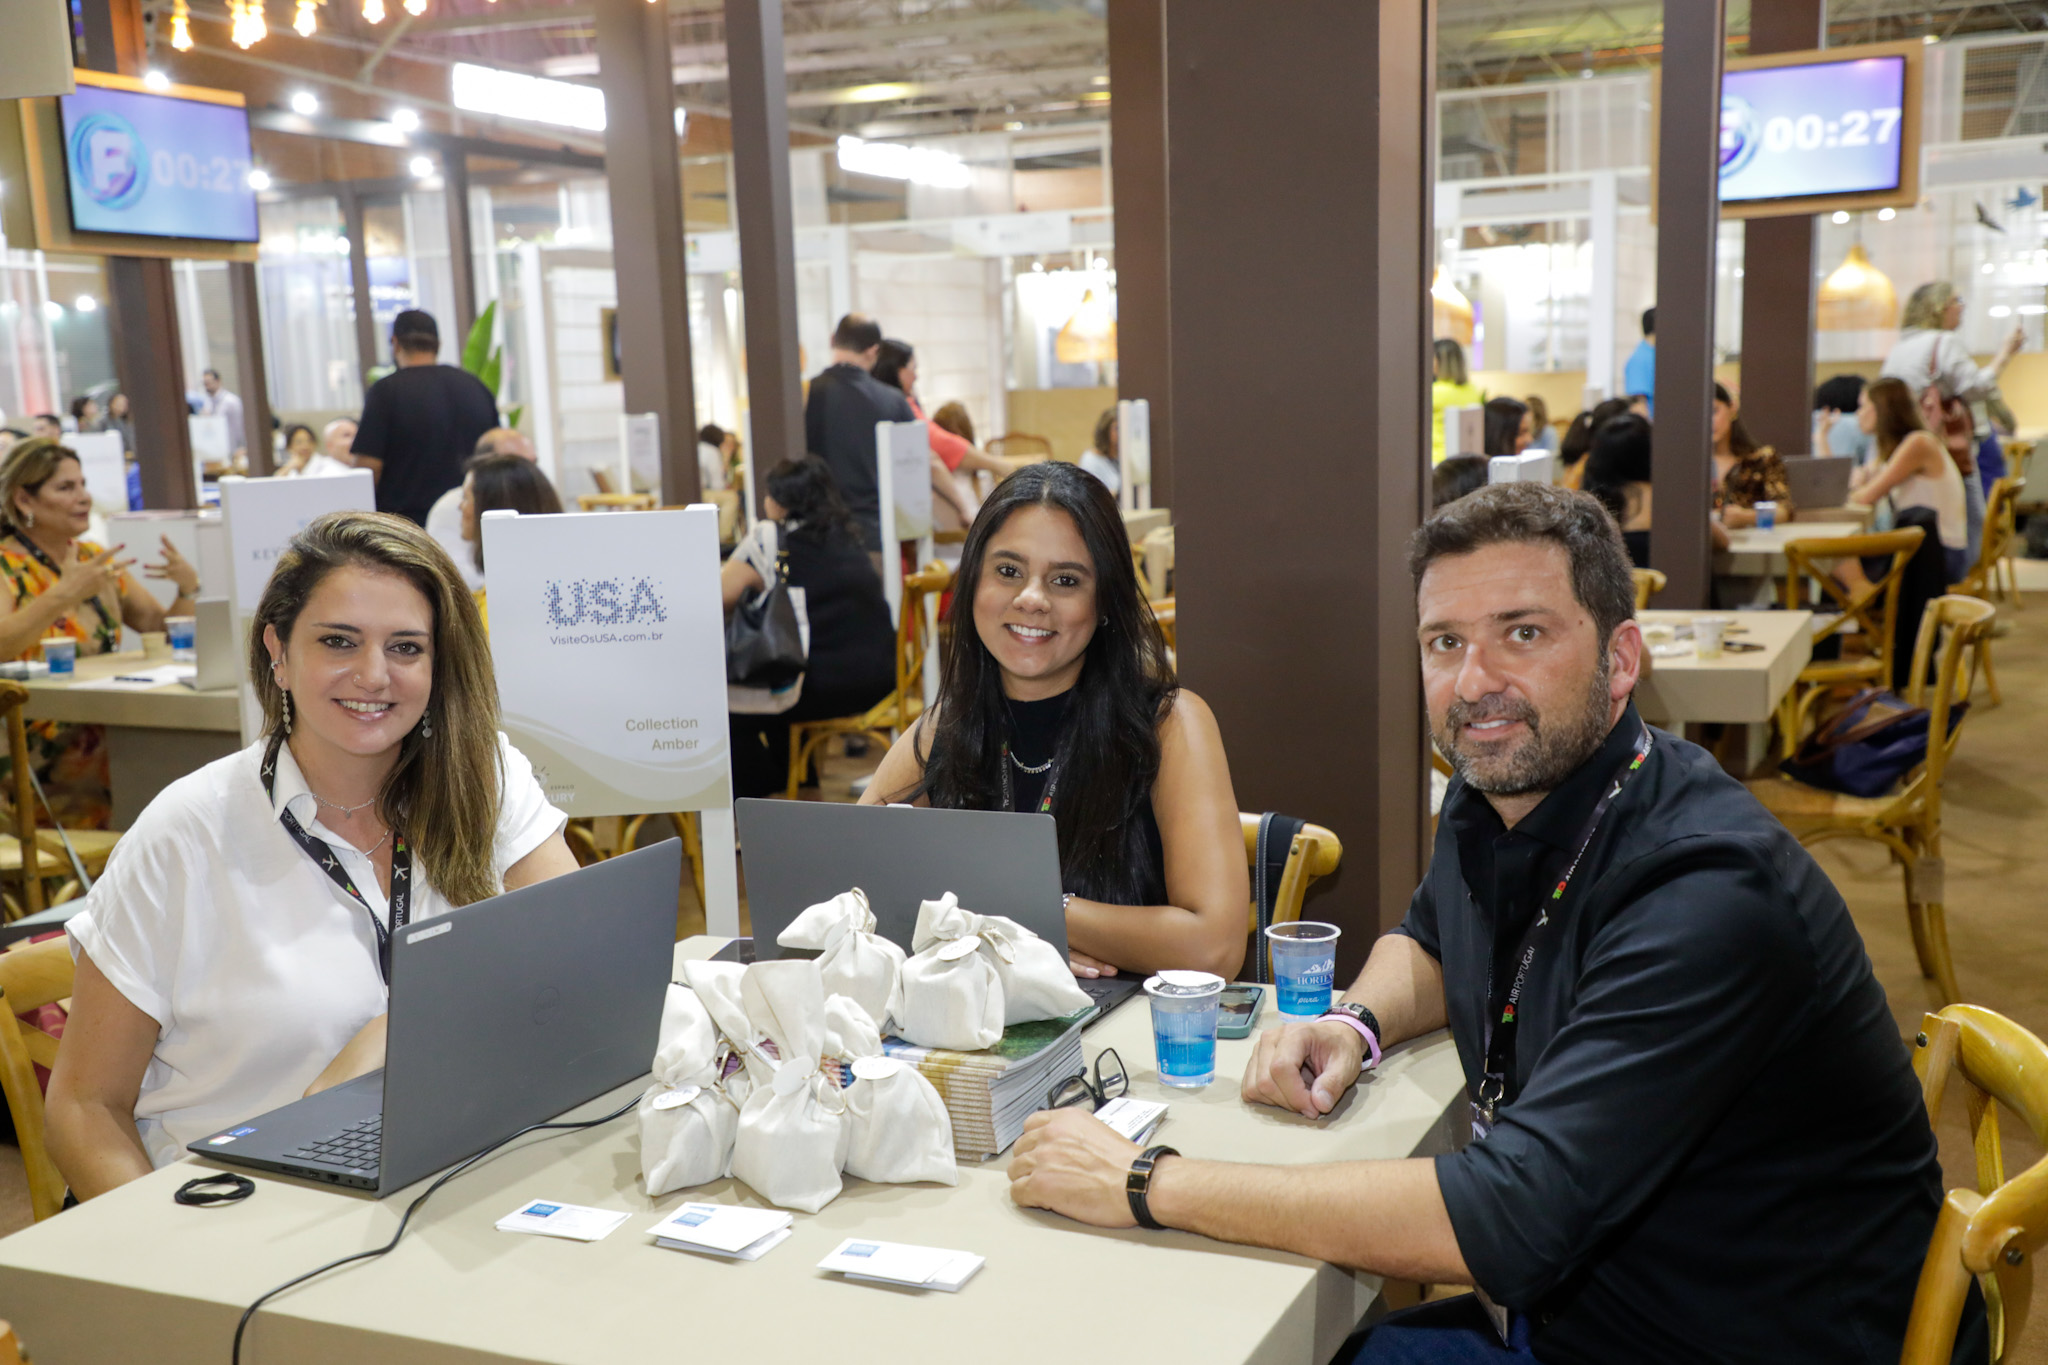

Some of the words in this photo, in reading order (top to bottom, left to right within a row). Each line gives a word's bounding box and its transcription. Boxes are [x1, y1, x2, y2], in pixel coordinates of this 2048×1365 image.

[1763, 107, 1901, 153] 00:27
[545, 577, 667, 628] USA
[550, 631, 664, 645] VisiteOsUSA.com.br
[625, 717, 698, 732] Collection
[651, 738, 699, 751] Amber
